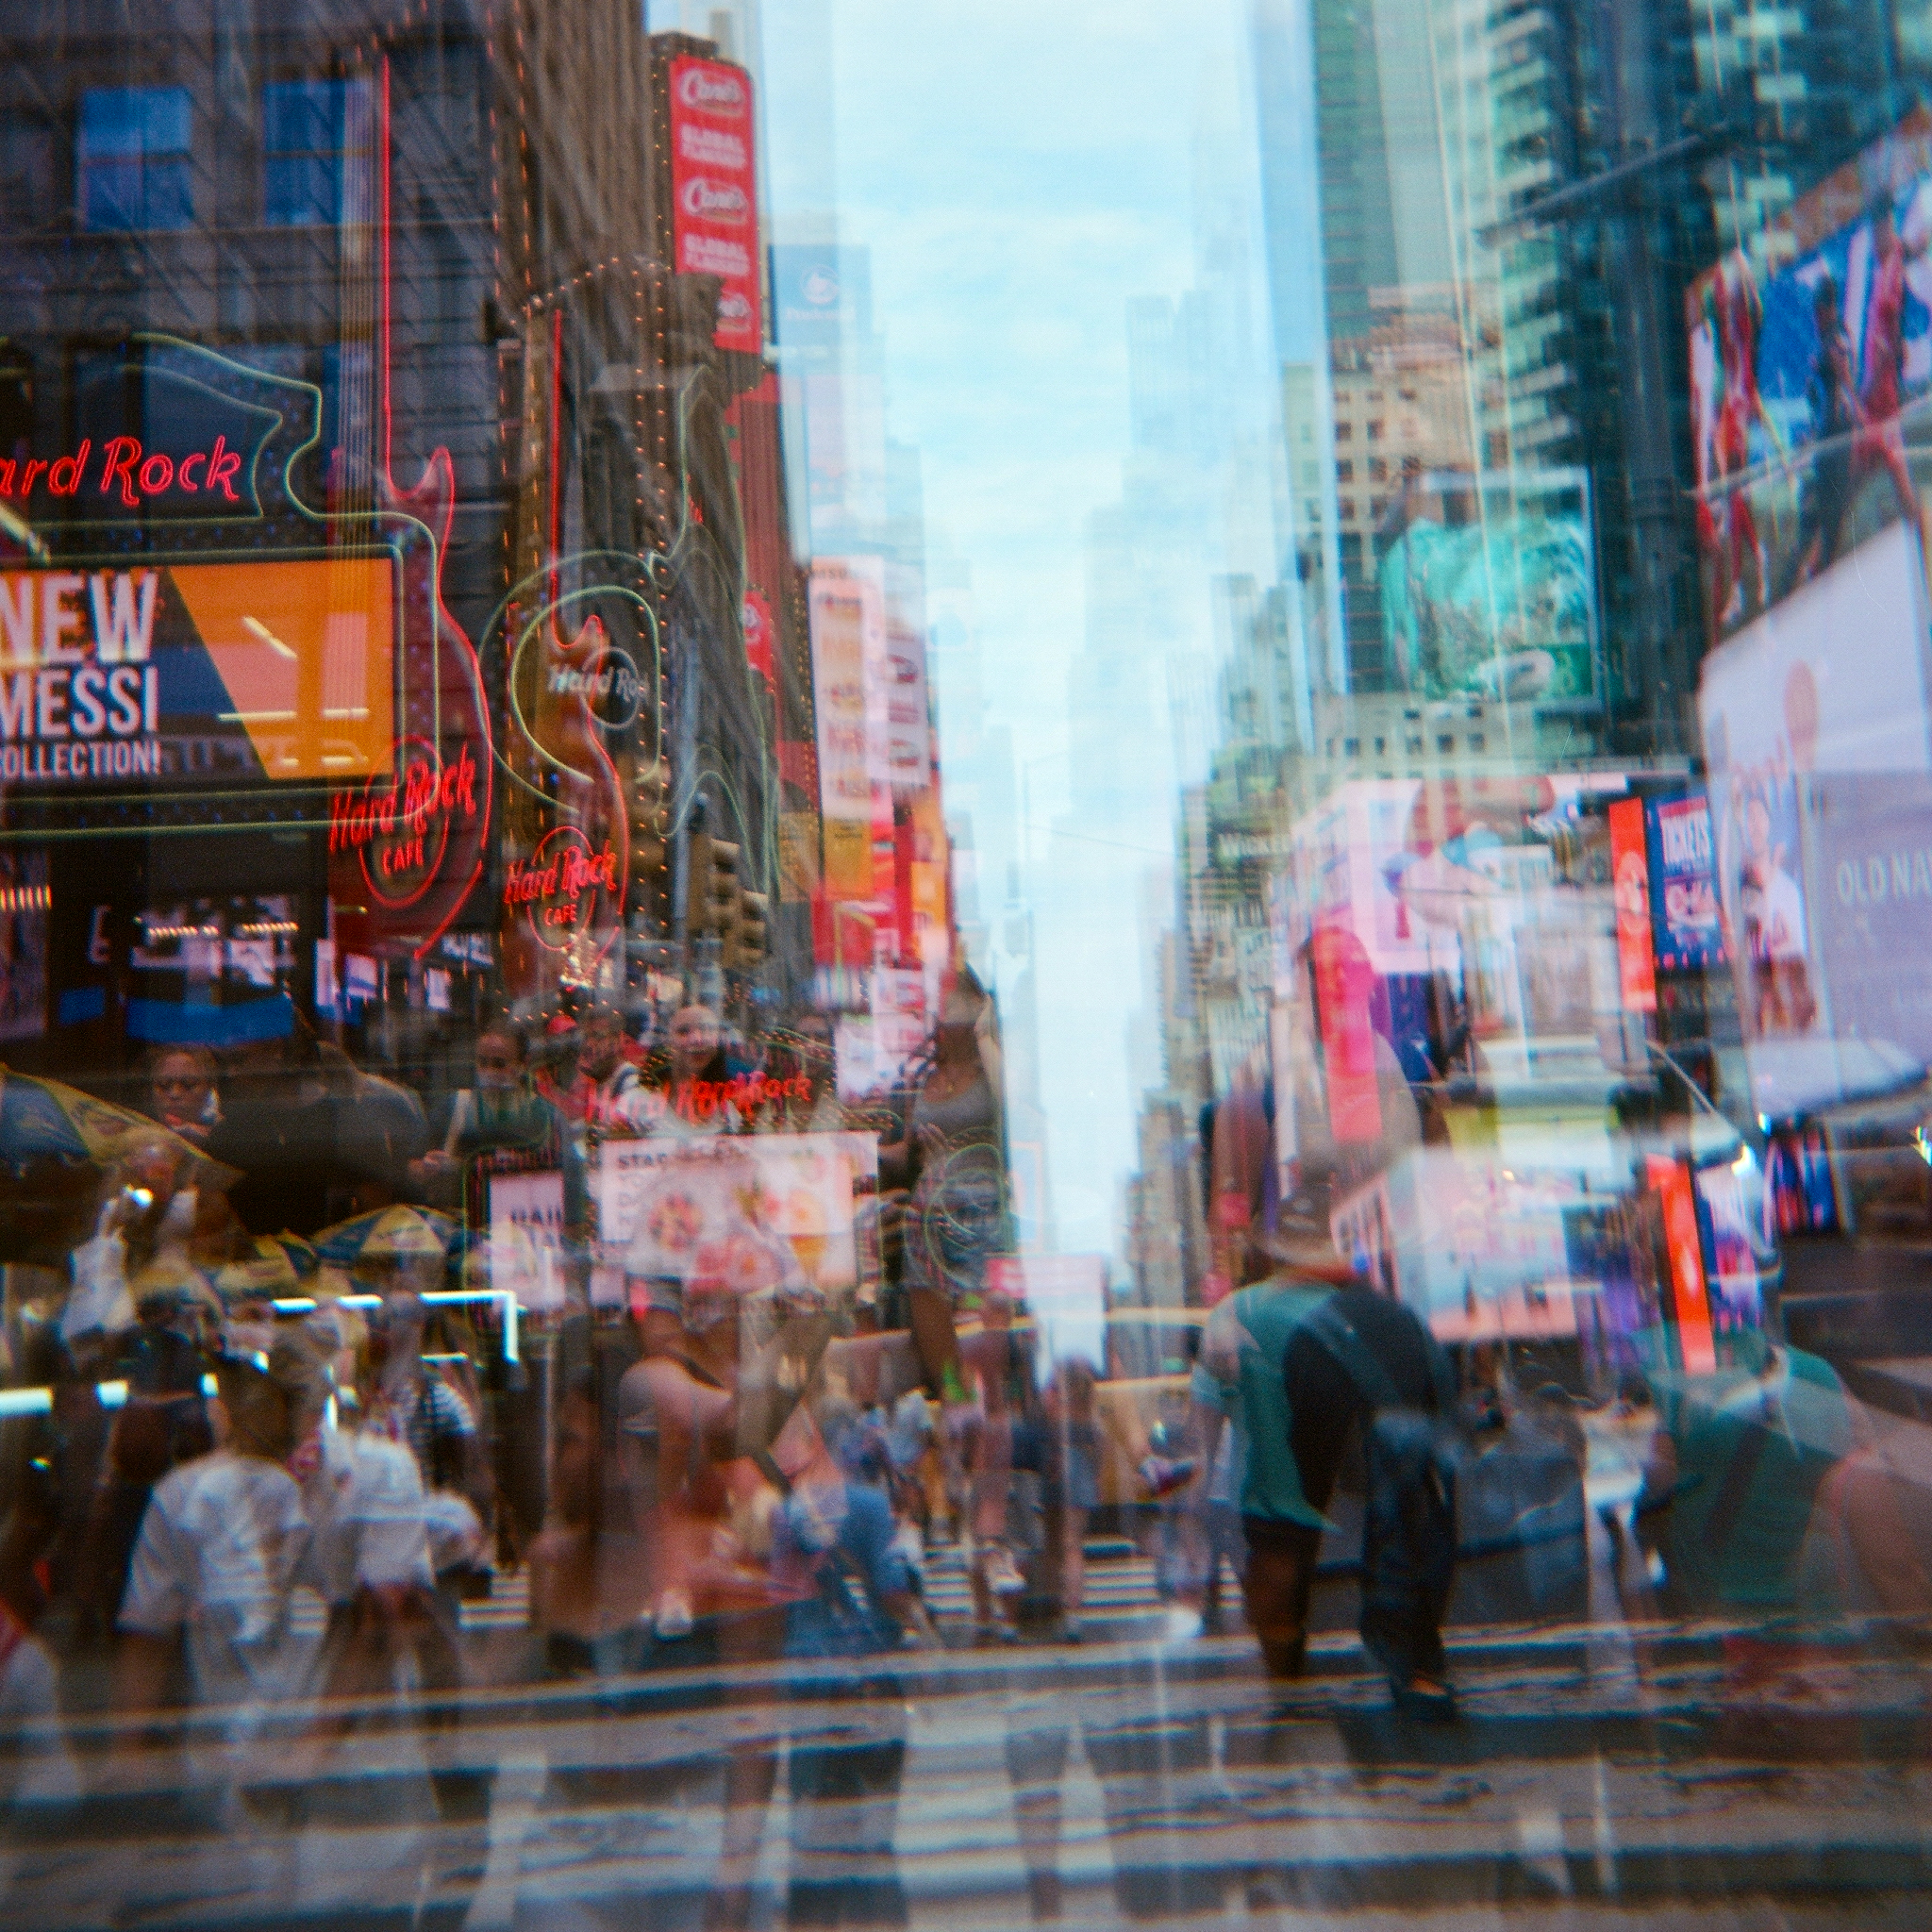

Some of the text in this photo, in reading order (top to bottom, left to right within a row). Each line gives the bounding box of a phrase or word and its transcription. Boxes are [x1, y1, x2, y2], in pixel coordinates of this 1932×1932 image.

[100, 435, 242, 507] Rock
[0, 574, 158, 662] NEW
[0, 740, 161, 780] OLLECTION!
[330, 741, 476, 854] Hard Rock
[503, 839, 617, 904] Hard Rock
[1838, 854, 1886, 907] OLD
